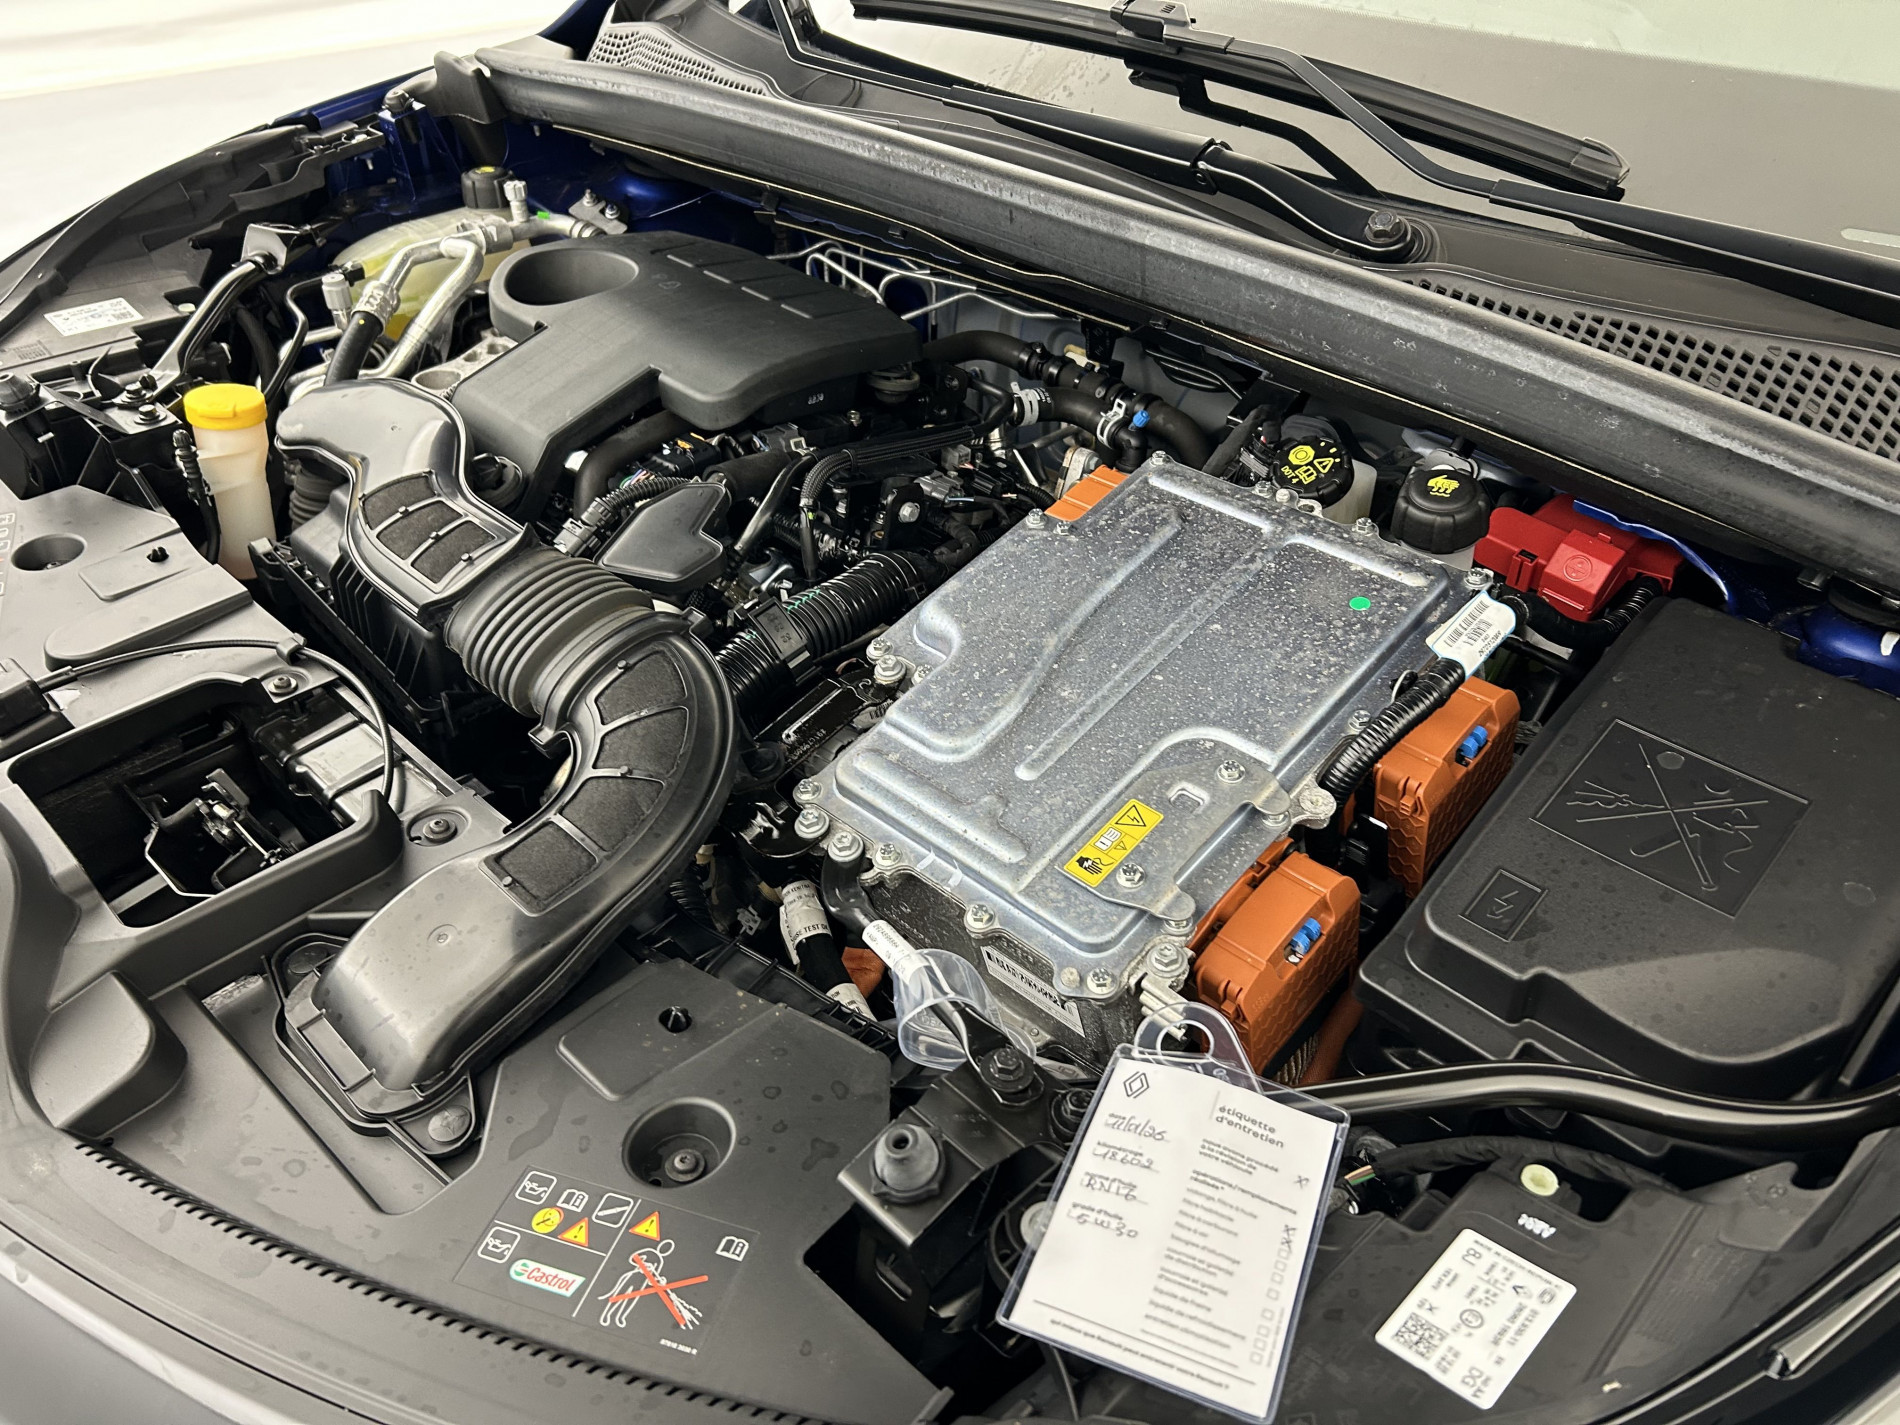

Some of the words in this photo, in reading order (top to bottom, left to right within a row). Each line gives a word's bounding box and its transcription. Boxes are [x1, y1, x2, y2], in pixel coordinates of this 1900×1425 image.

[1281, 465, 1296, 478] DOT
[804, 923, 820, 933] TEST
[1215, 1115, 1284, 1148] d'entretien
[1218, 1106, 1276, 1134] étiquette
[526, 1266, 576, 1293] Castrol
